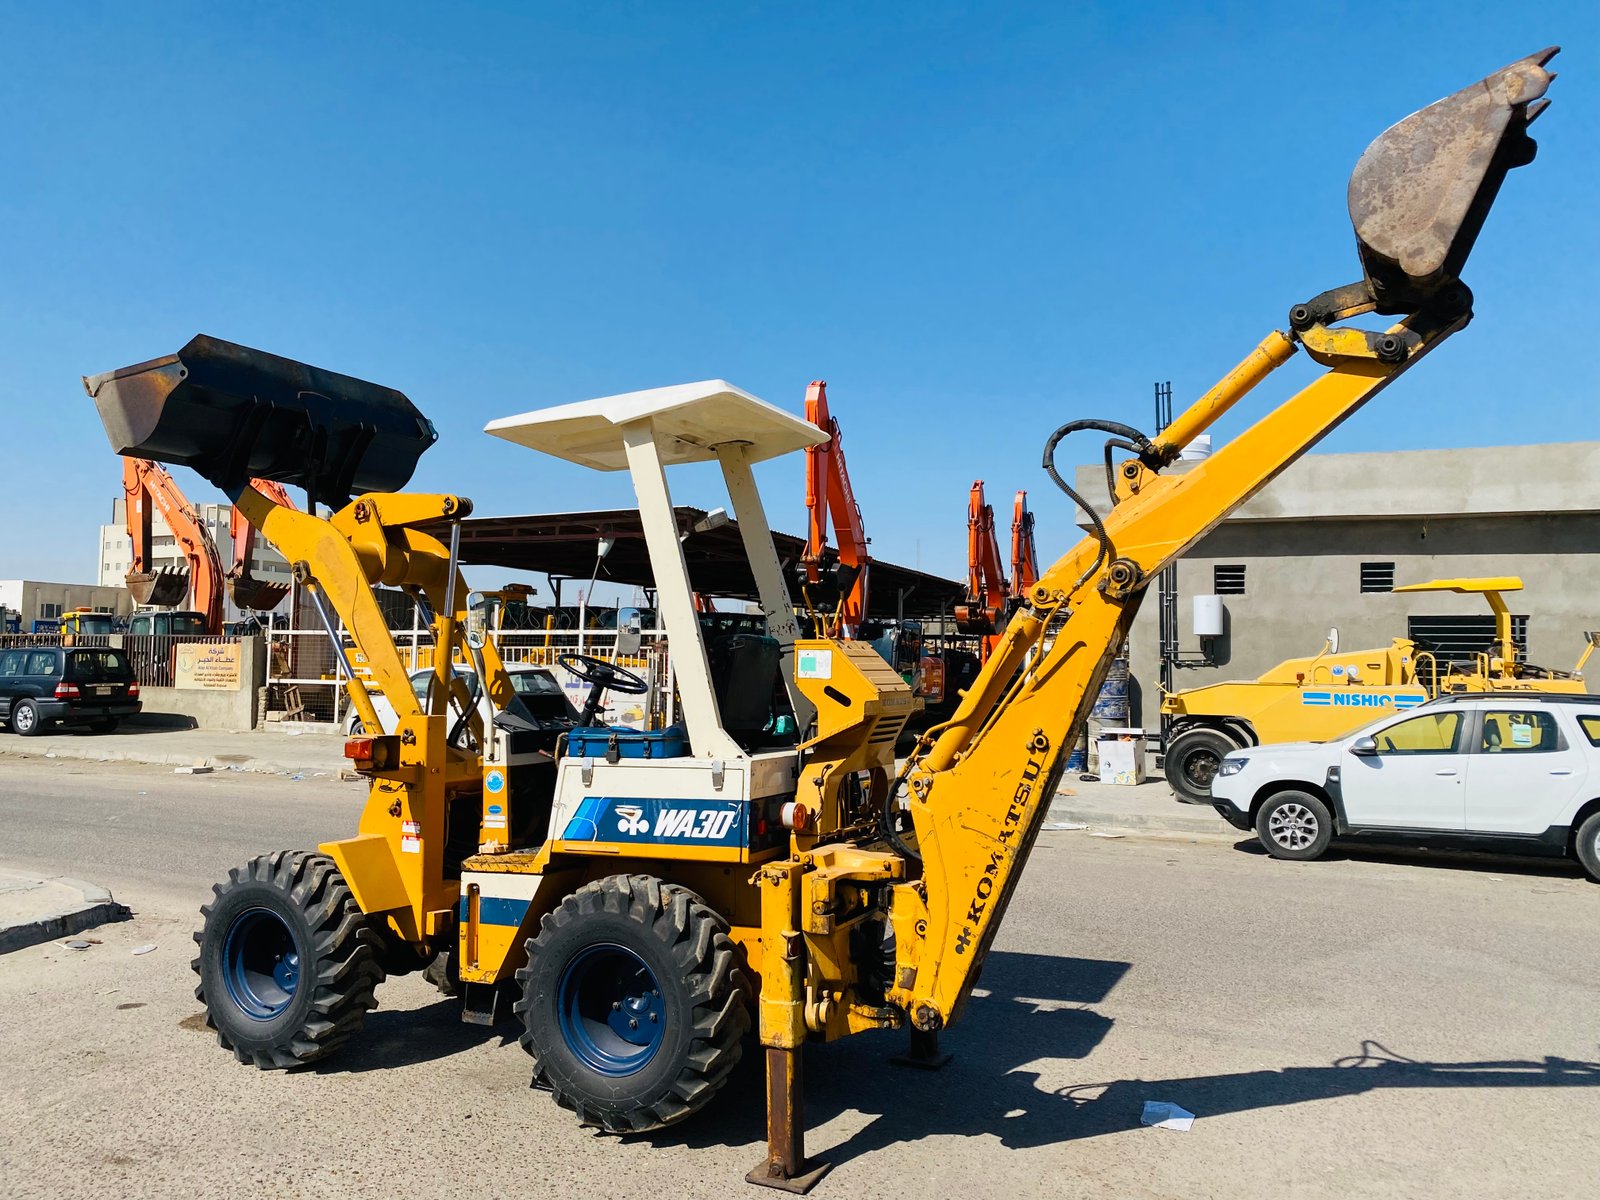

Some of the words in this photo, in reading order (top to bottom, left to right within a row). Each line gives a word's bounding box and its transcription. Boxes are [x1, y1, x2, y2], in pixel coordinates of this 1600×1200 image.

[836, 453, 850, 503] HITACHI
[150, 481, 170, 511] HITACHI
[208, 647, 224, 655] شركة
[653, 809, 736, 839] WA30
[966, 757, 1042, 926] KOMATSU
